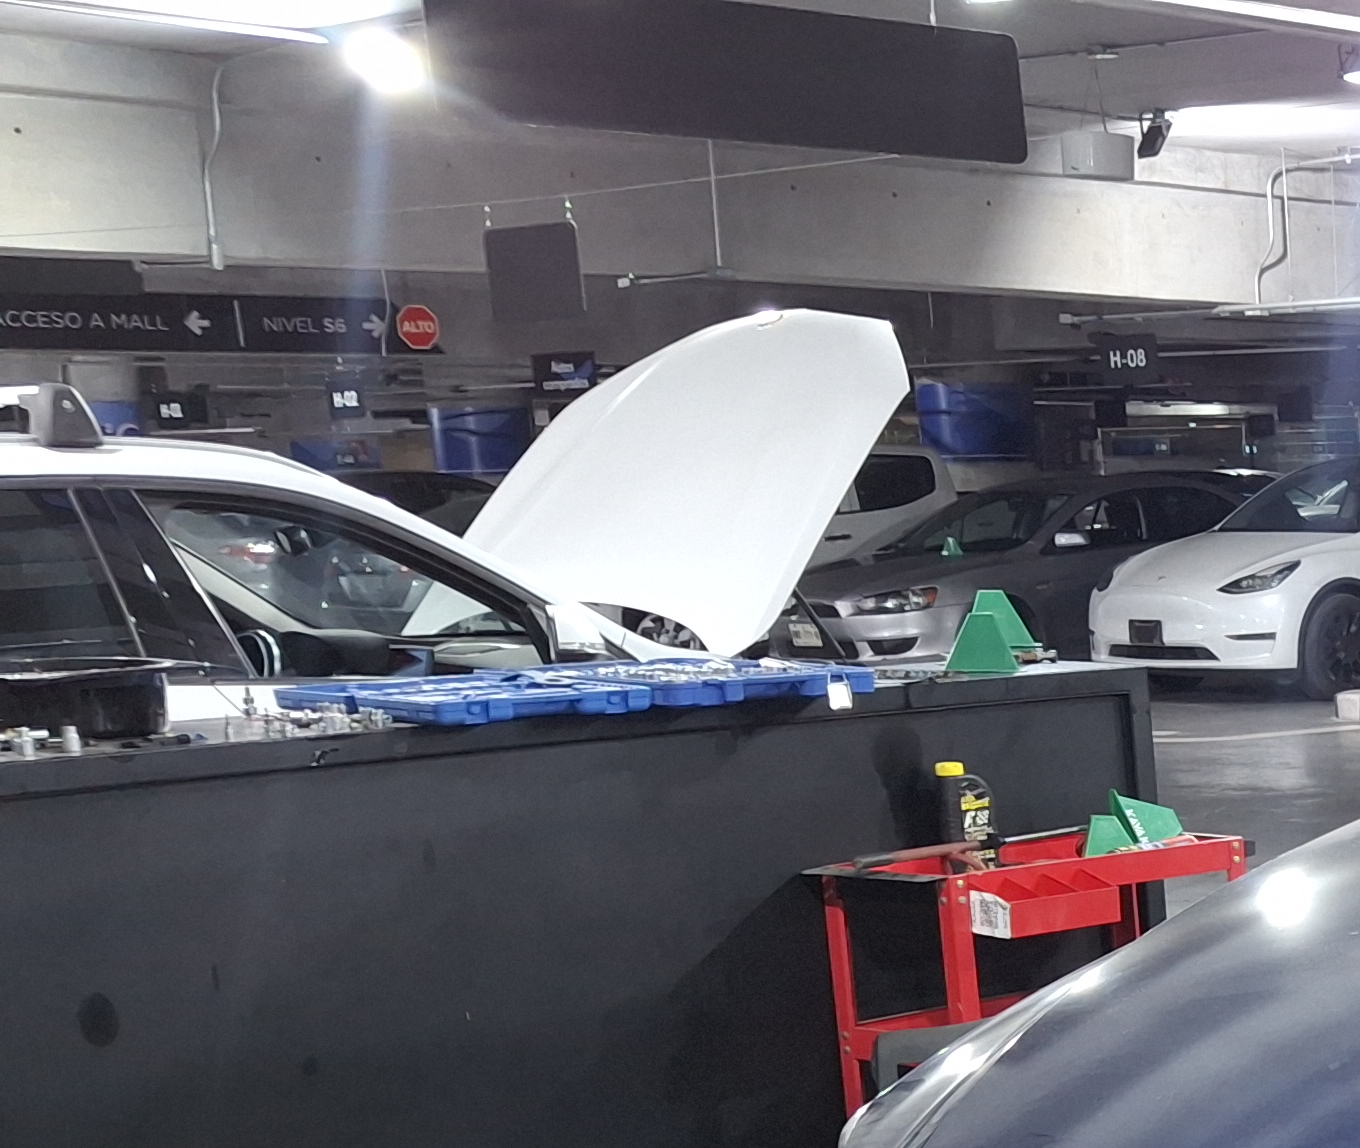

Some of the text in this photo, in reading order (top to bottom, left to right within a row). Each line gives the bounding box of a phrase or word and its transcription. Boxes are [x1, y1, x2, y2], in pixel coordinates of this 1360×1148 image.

[89, 312, 106, 329] A
[110, 313, 170, 331] MALL
[262, 316, 347, 334] NIVEL S6
[402, 320, 436, 334] ALTO
[1109, 348, 1147, 369] H-08
